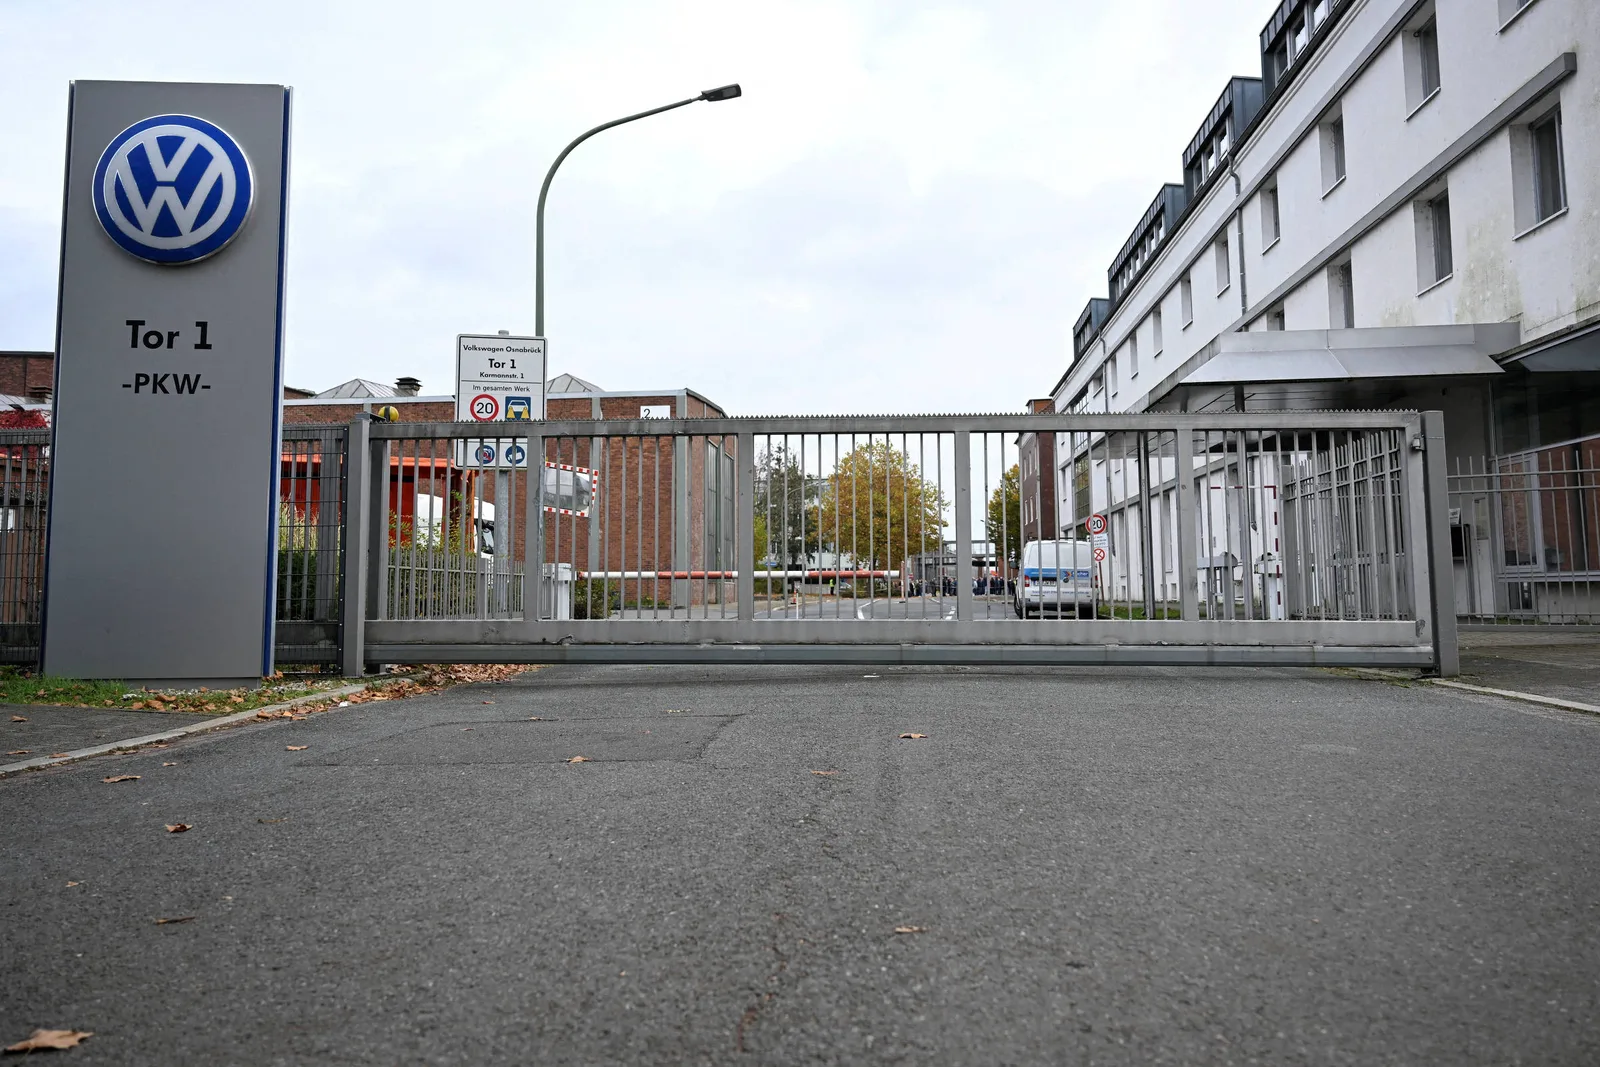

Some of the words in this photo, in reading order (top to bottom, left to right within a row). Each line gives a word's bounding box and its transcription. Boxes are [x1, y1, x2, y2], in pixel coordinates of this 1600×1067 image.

[125, 319, 180, 349] Tor
[194, 321, 213, 350] 1
[463, 345, 504, 353] Volkswagen
[505, 345, 541, 354] Osnabrück
[488, 358, 506, 369] Tor
[510, 359, 517, 369] 1
[479, 371, 519, 379] Karmannstr.
[122, 373, 211, 395] -PKW-
[476, 402, 494, 414] 20
